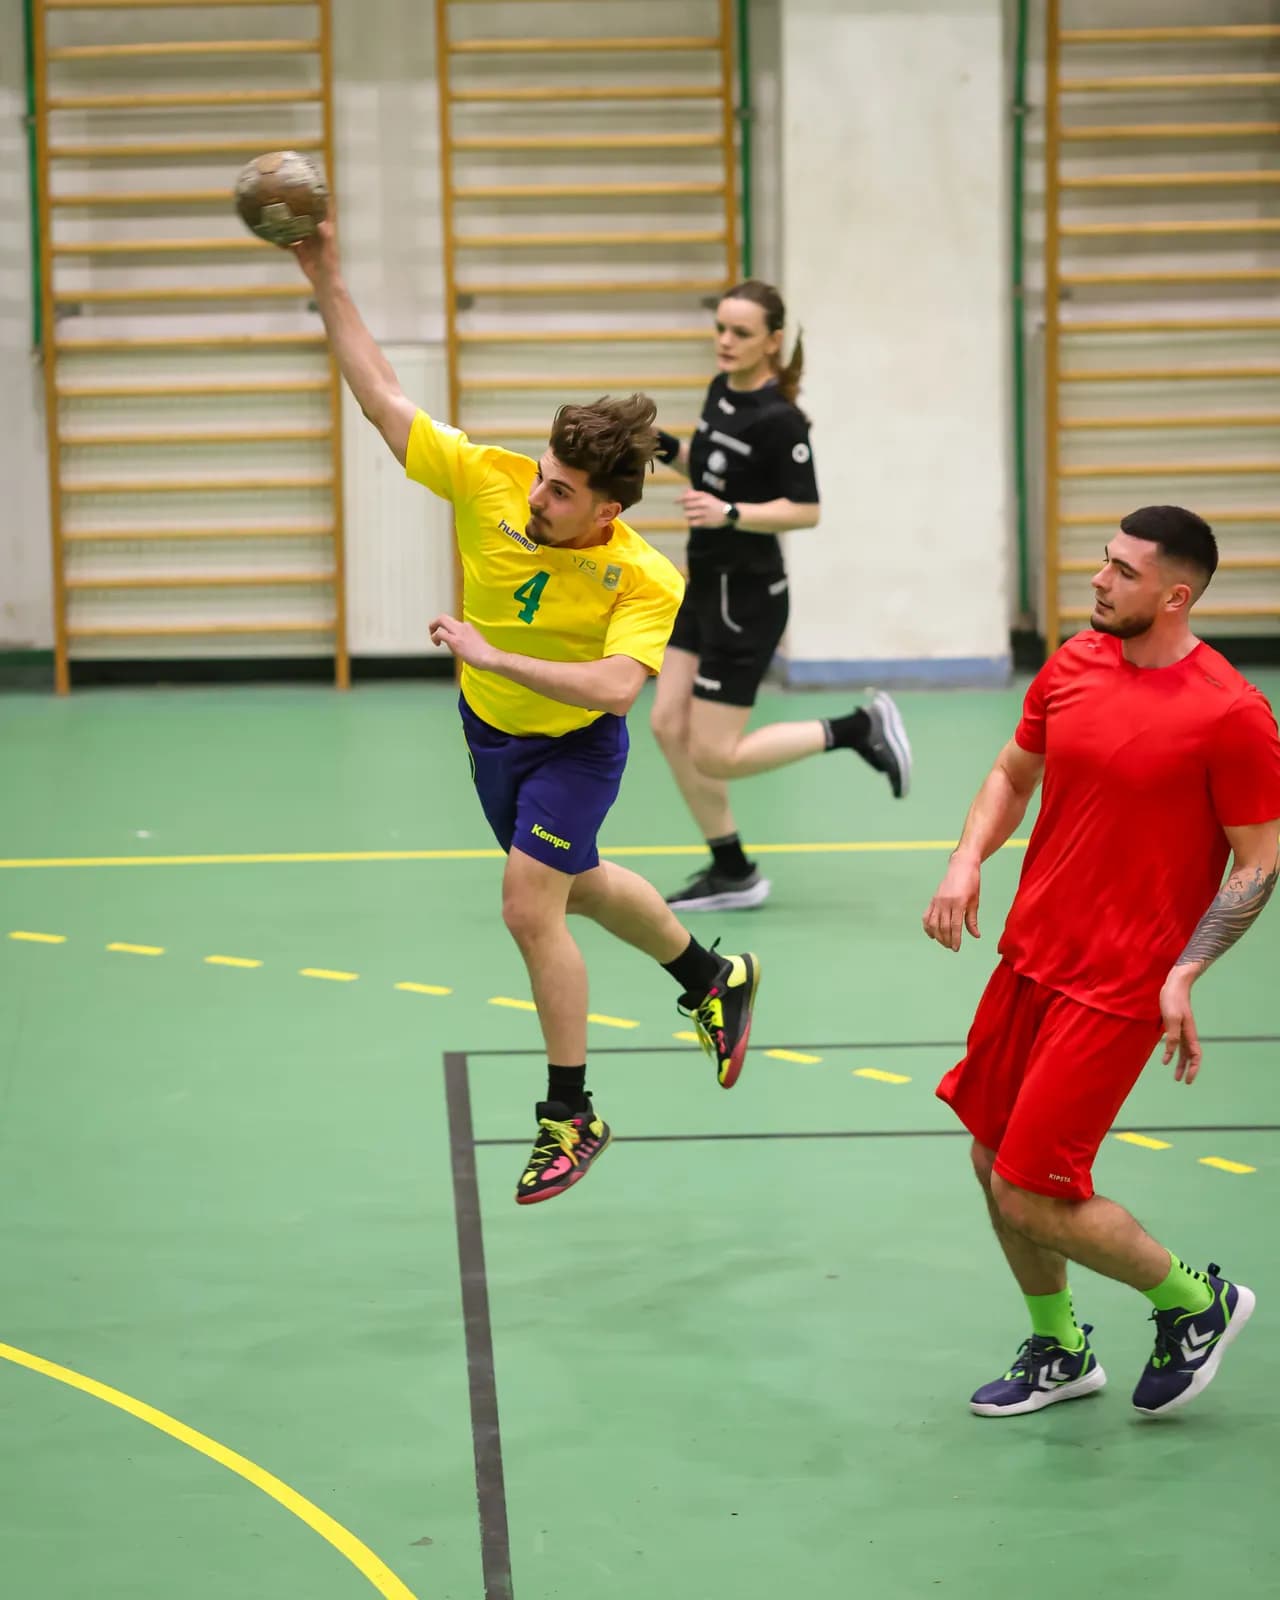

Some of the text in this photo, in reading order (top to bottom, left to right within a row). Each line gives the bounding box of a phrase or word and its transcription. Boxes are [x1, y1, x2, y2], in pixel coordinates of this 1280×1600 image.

[498, 519, 539, 552] hummel
[513, 570, 551, 625] 4
[531, 823, 571, 850] Kempa
